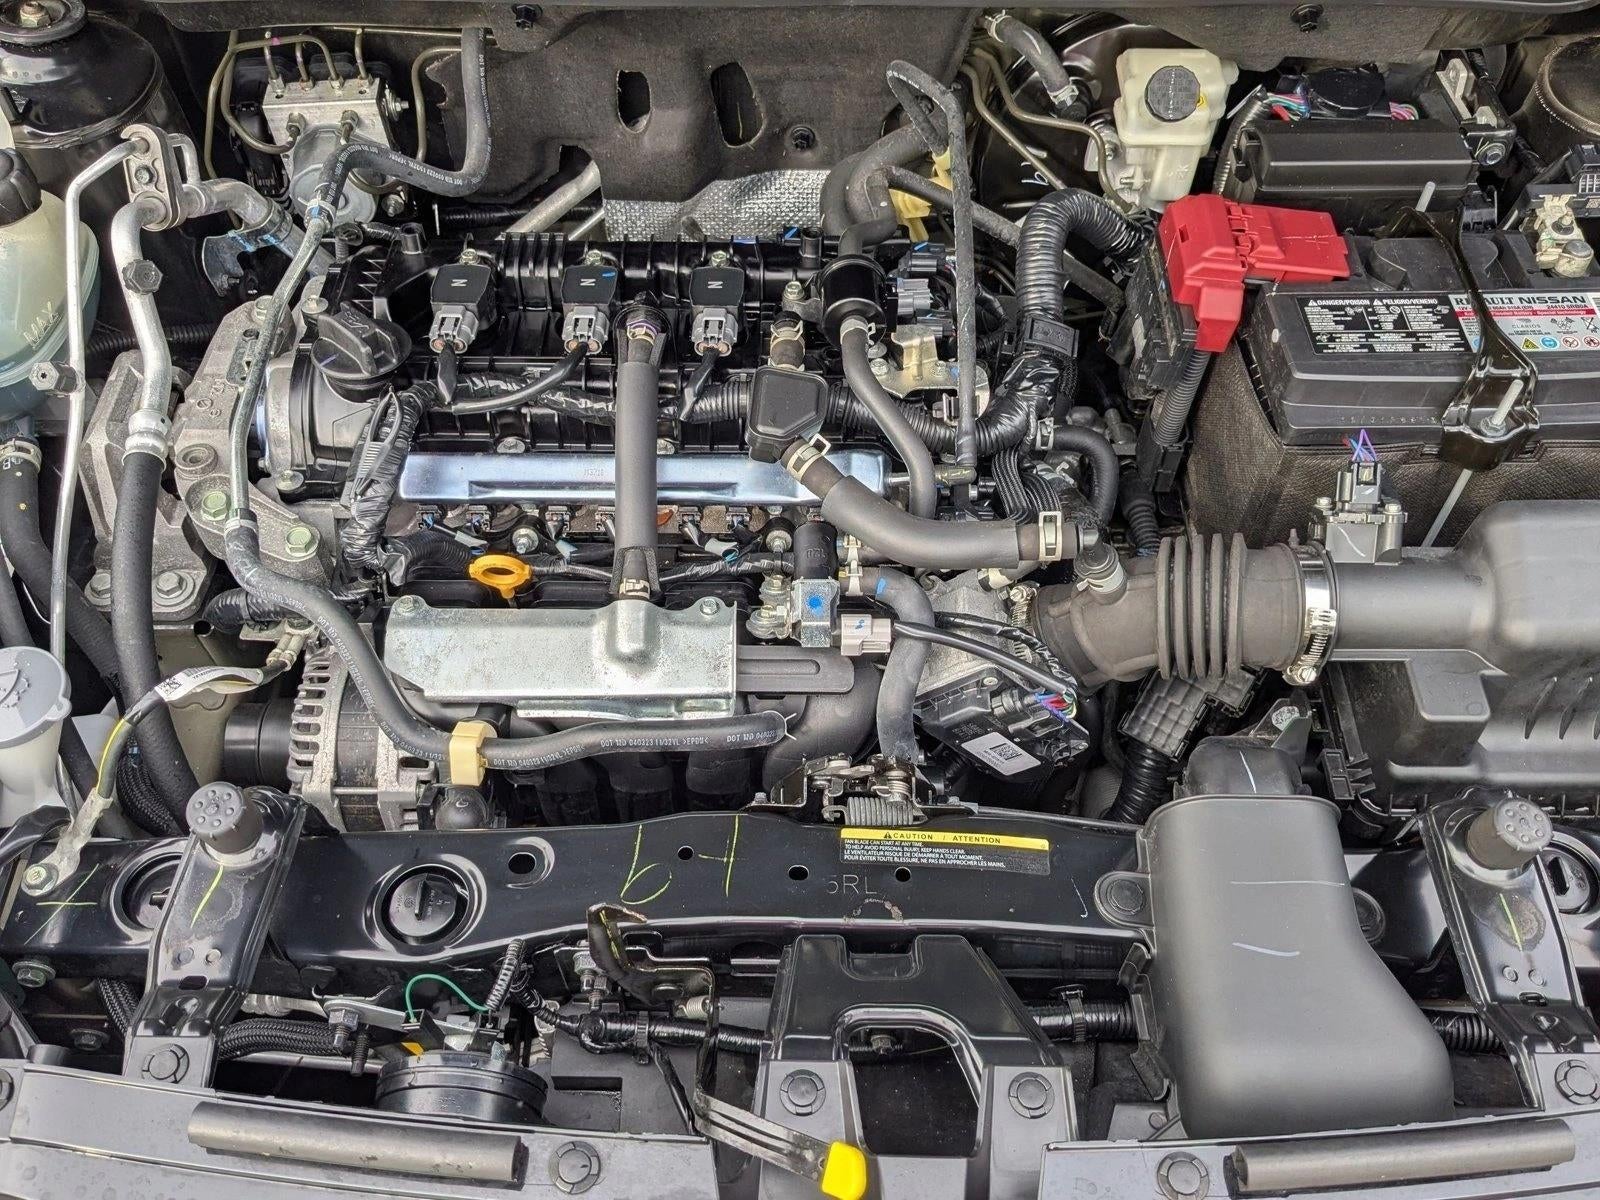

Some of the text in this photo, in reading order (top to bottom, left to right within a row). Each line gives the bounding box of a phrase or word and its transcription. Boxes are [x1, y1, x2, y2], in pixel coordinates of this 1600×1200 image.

[1454, 296, 1586, 305] RAULT NISSAN
[23, 301, 62, 347] MAX
[953, 835, 1000, 843] ATTENTION
